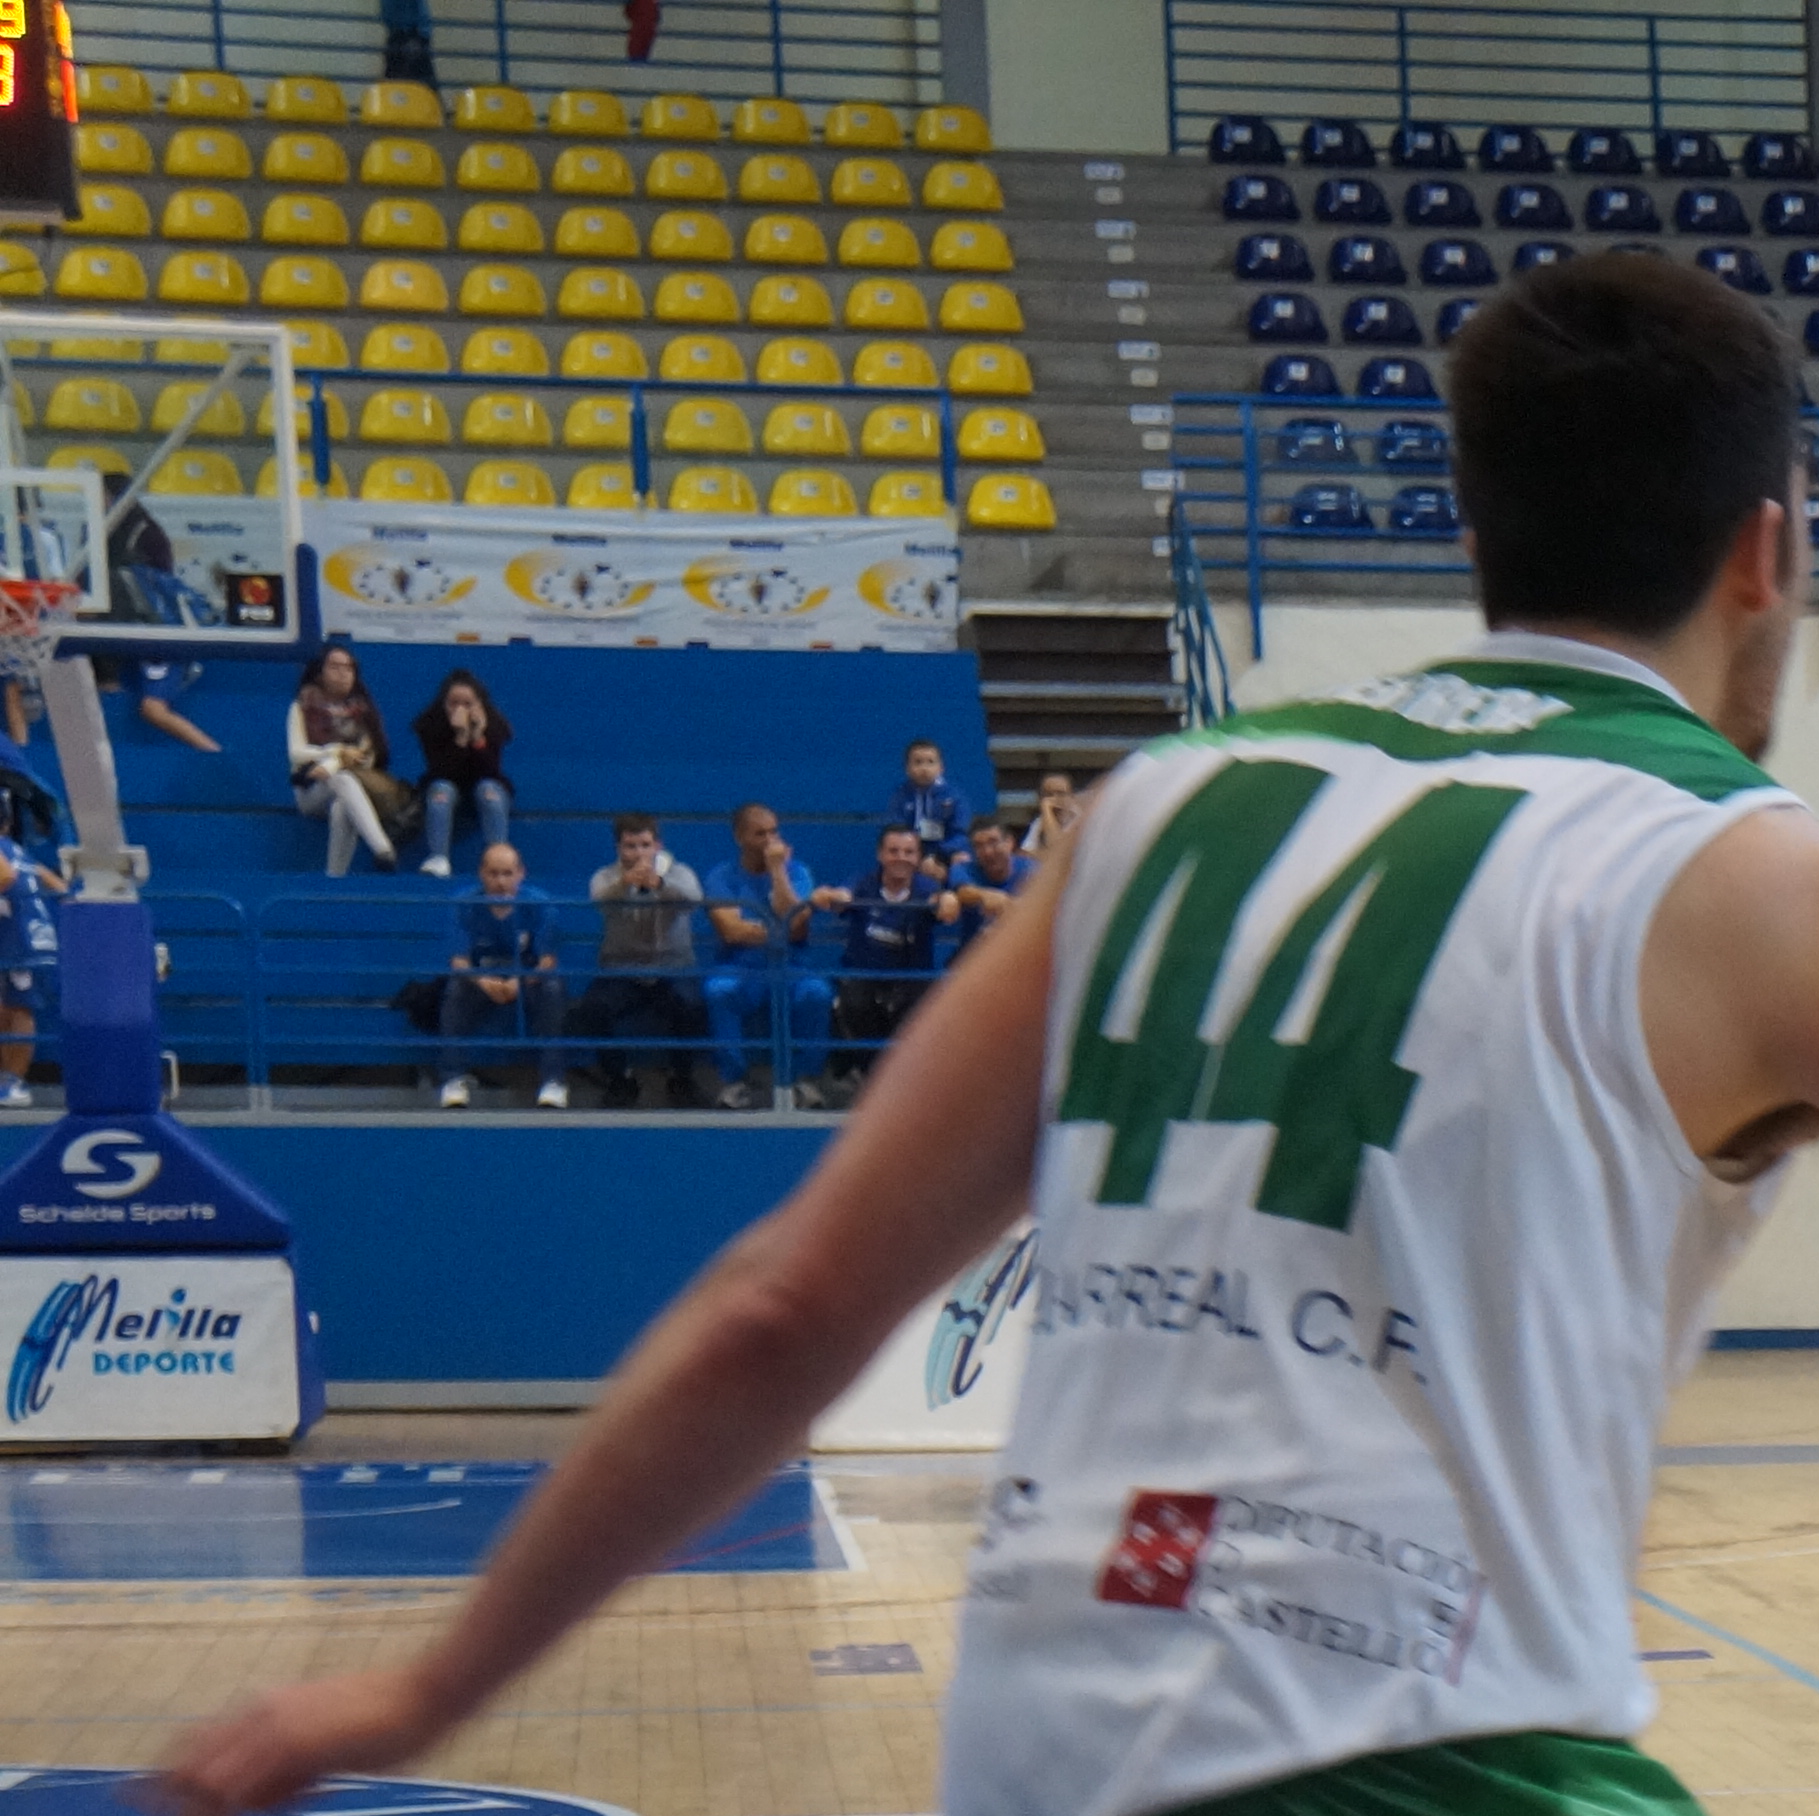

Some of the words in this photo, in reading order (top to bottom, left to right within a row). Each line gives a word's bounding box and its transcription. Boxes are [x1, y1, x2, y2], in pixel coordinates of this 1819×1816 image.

[1058, 758, 1533, 1234] 44
[130, 1203, 216, 1225] Sports
[93, 1351, 235, 1375] DEPORTE
